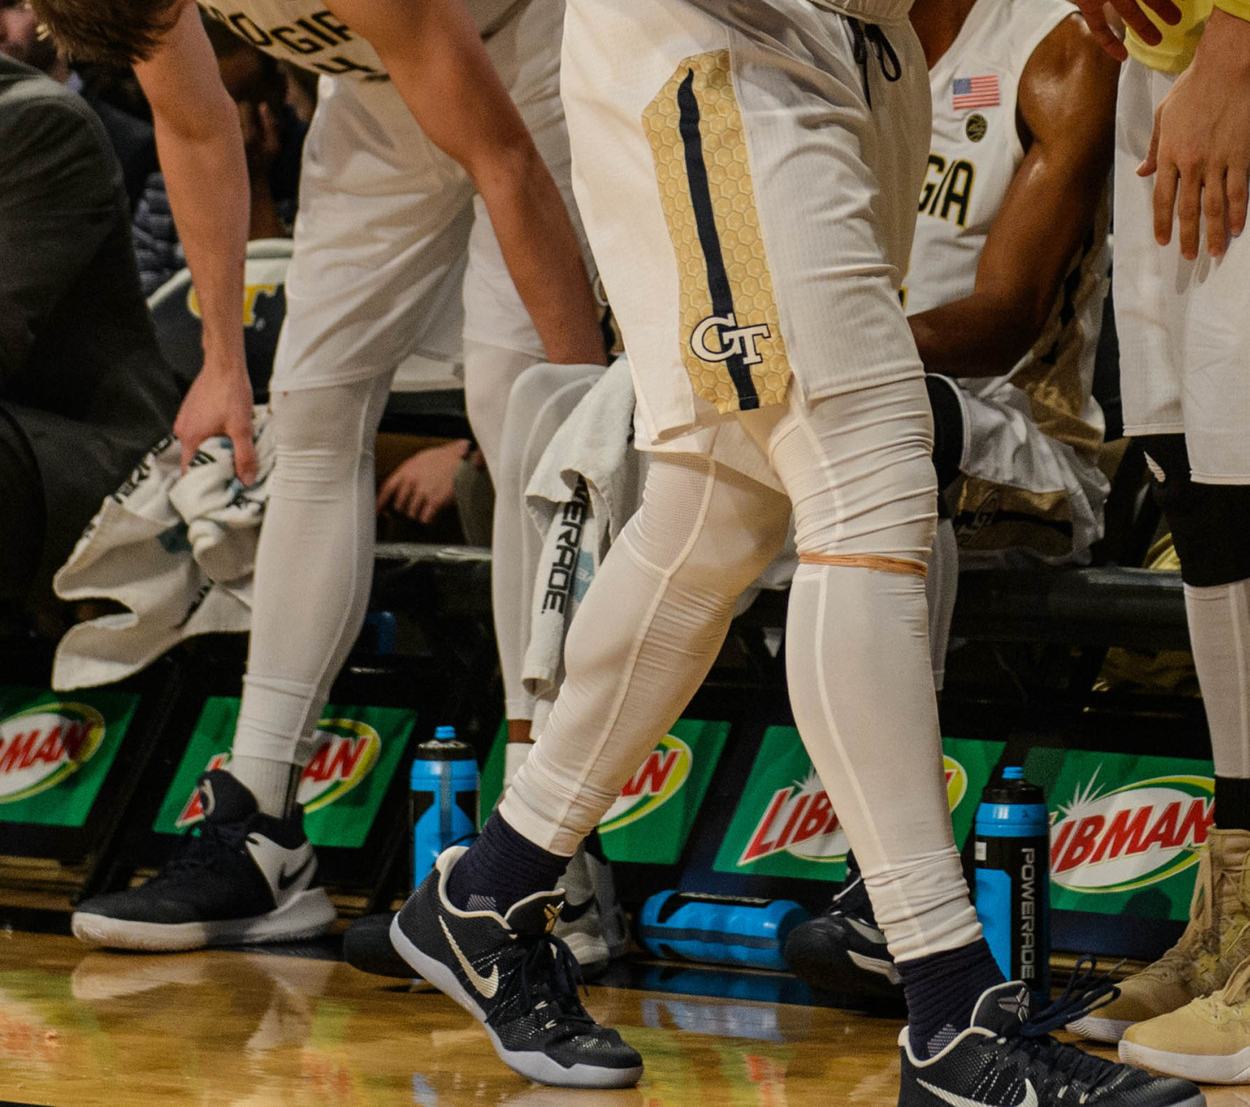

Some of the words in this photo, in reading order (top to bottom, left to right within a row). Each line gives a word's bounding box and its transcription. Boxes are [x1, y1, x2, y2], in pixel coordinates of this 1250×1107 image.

[0, 721, 95, 775] MAN
[1048, 797, 1216, 875] IBMAN
[1020, 847, 1036, 980] POWERADE
